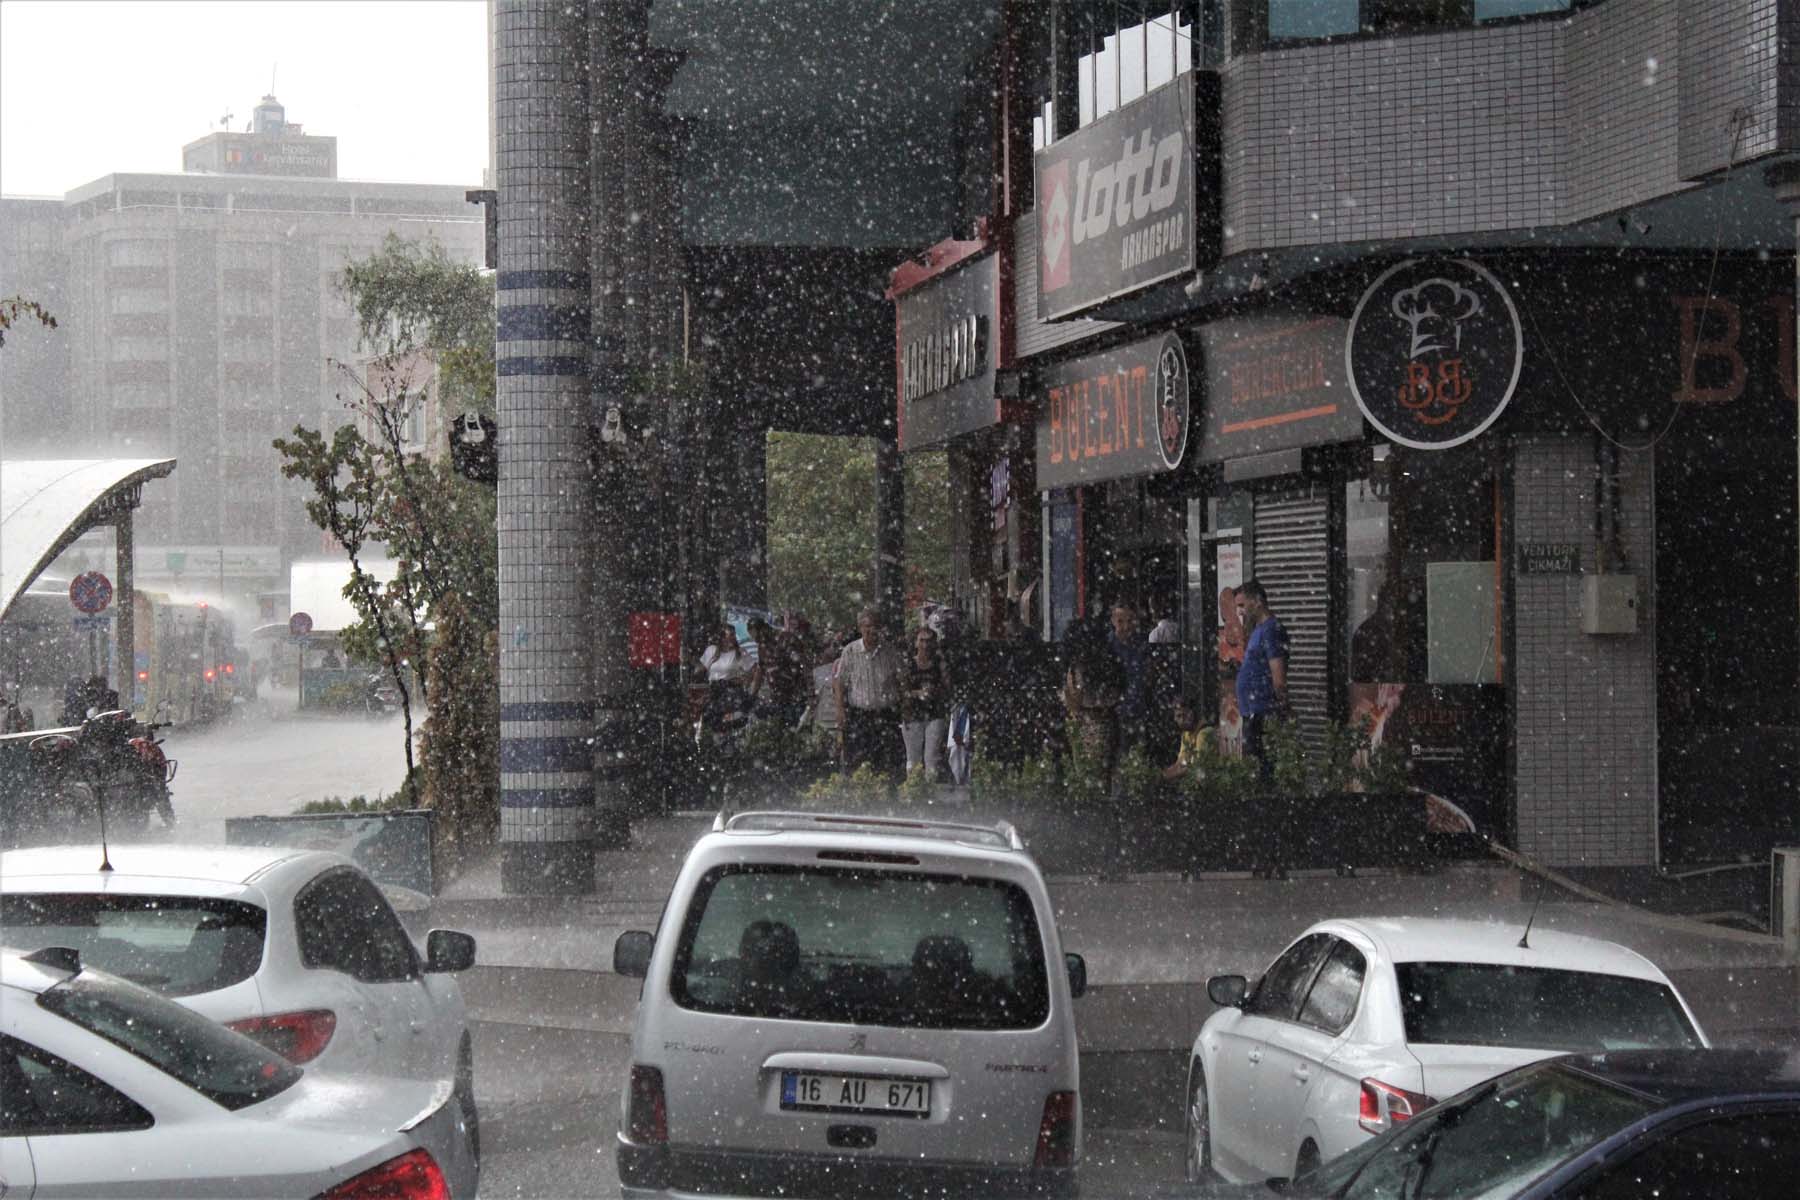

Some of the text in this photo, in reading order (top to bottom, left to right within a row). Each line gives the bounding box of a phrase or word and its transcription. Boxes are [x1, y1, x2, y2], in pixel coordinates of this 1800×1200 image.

[1073, 127, 1183, 245] lotto
[1121, 212, 1184, 272] HAKANSPOR
[800, 1077, 925, 1109] 16 AU 671
